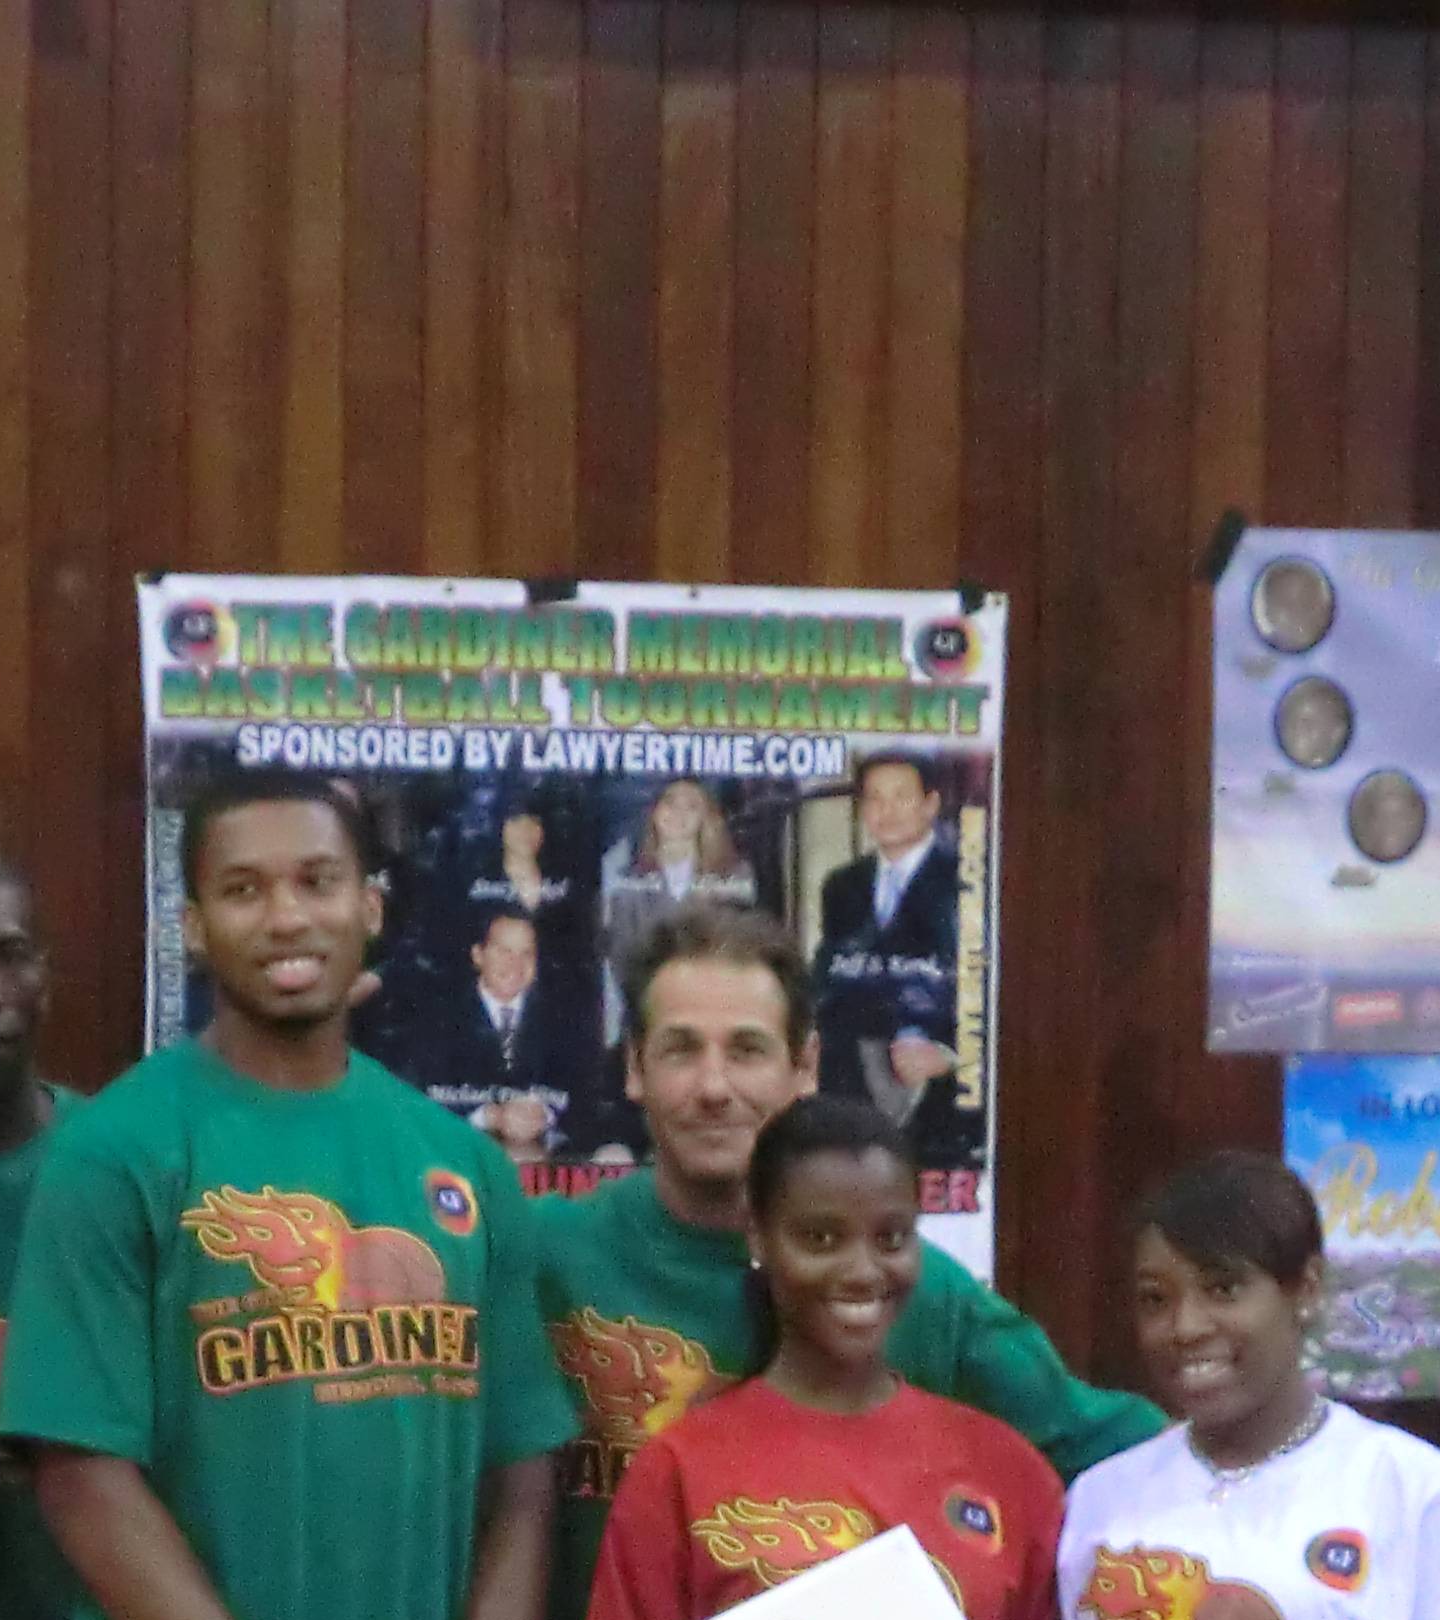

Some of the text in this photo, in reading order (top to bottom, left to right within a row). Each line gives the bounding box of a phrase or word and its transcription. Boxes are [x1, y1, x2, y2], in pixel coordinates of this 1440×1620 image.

[235, 723, 846, 776] SPONSORED BY LAWYERTIME.COM
